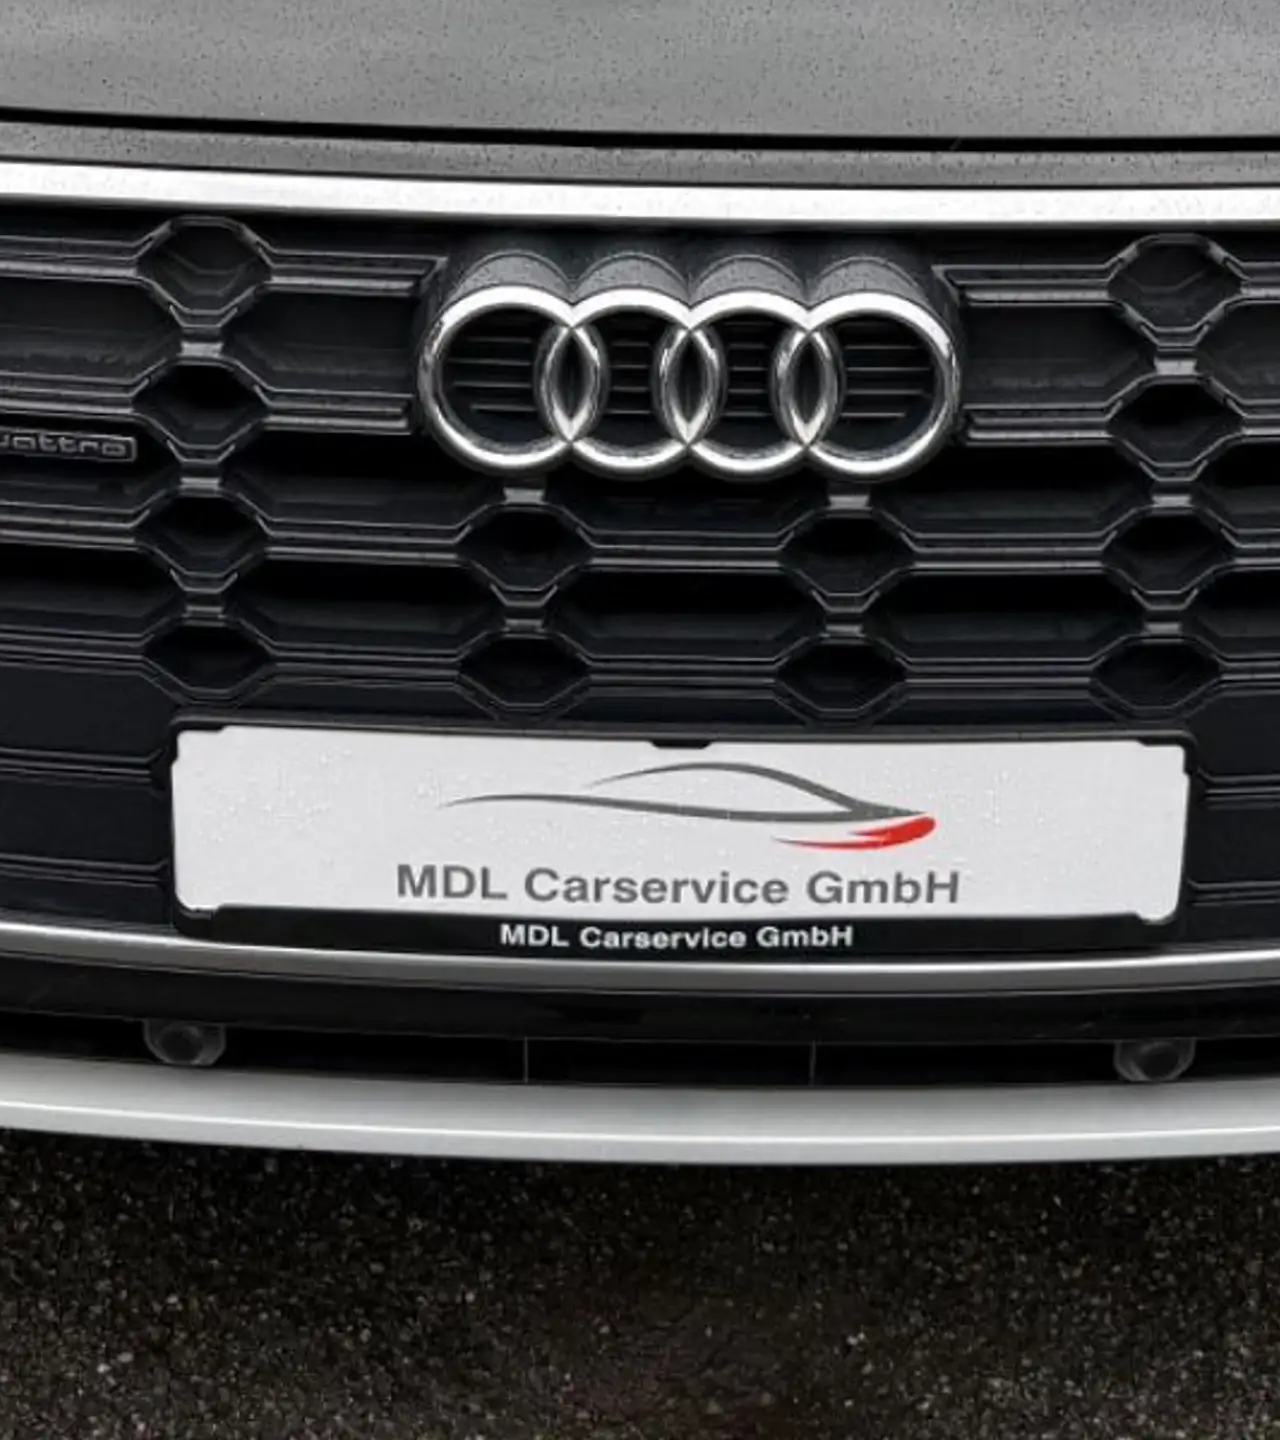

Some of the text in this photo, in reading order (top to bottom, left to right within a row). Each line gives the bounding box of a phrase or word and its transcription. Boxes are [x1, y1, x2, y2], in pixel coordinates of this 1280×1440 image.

[397, 863, 961, 905] MDL Carservice GmbH
[500, 923, 853, 950] MDL Carservice GmbH
